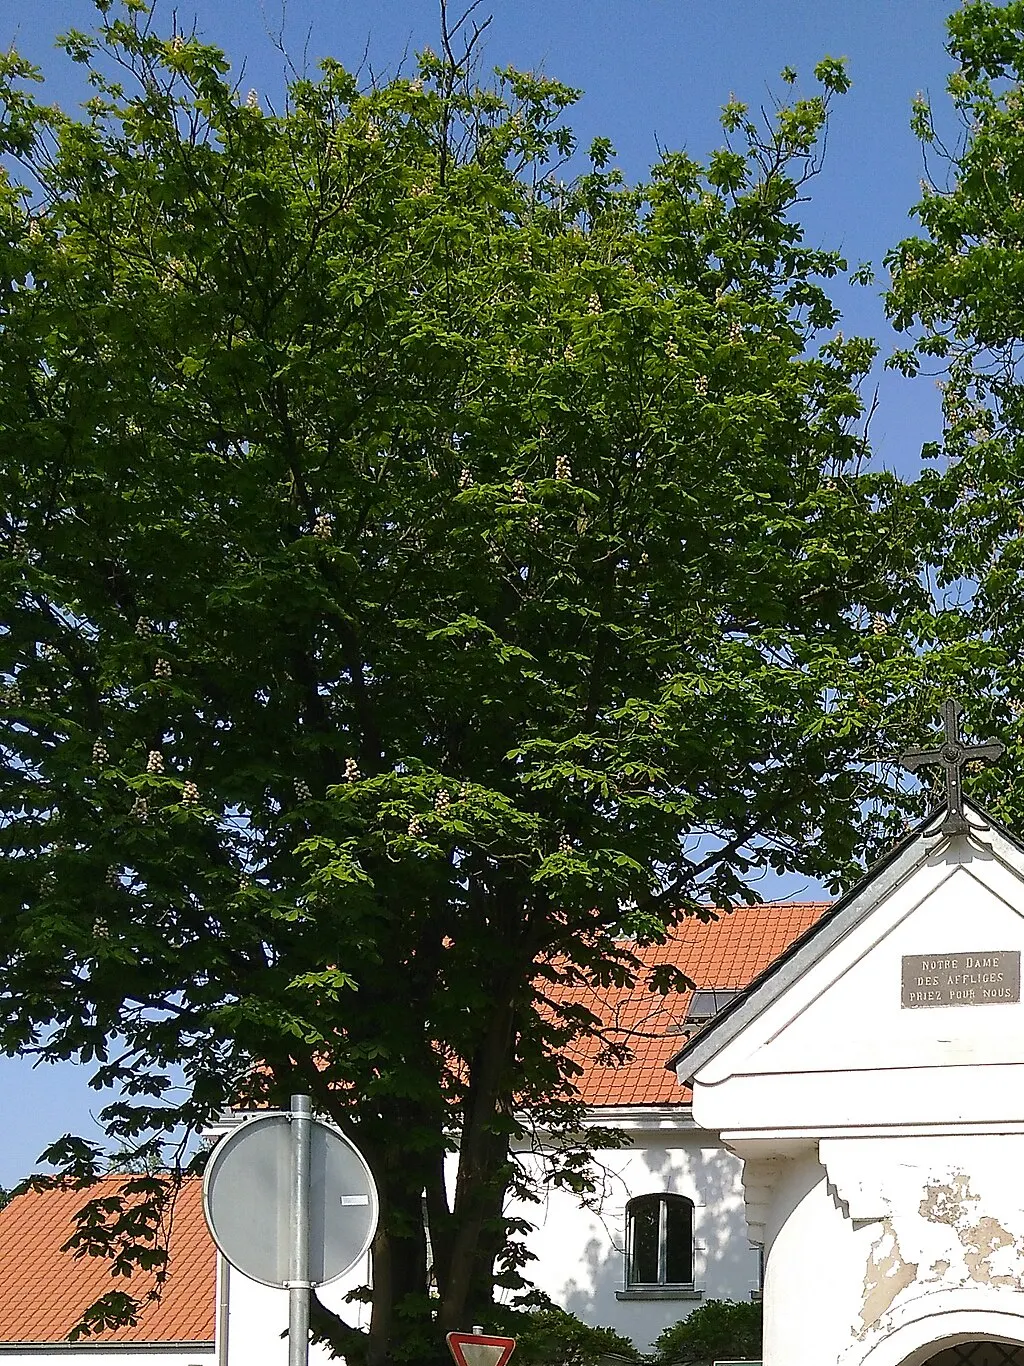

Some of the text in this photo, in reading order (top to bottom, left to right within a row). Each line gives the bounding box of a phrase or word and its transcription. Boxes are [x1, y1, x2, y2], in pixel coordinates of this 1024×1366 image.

[922, 957, 999, 971] NOTRE DAME
[917, 973, 1004, 986] DES AFFLIGES
[909, 991, 942, 1002] PRIEZ
[949, 989, 975, 1000] POUR
